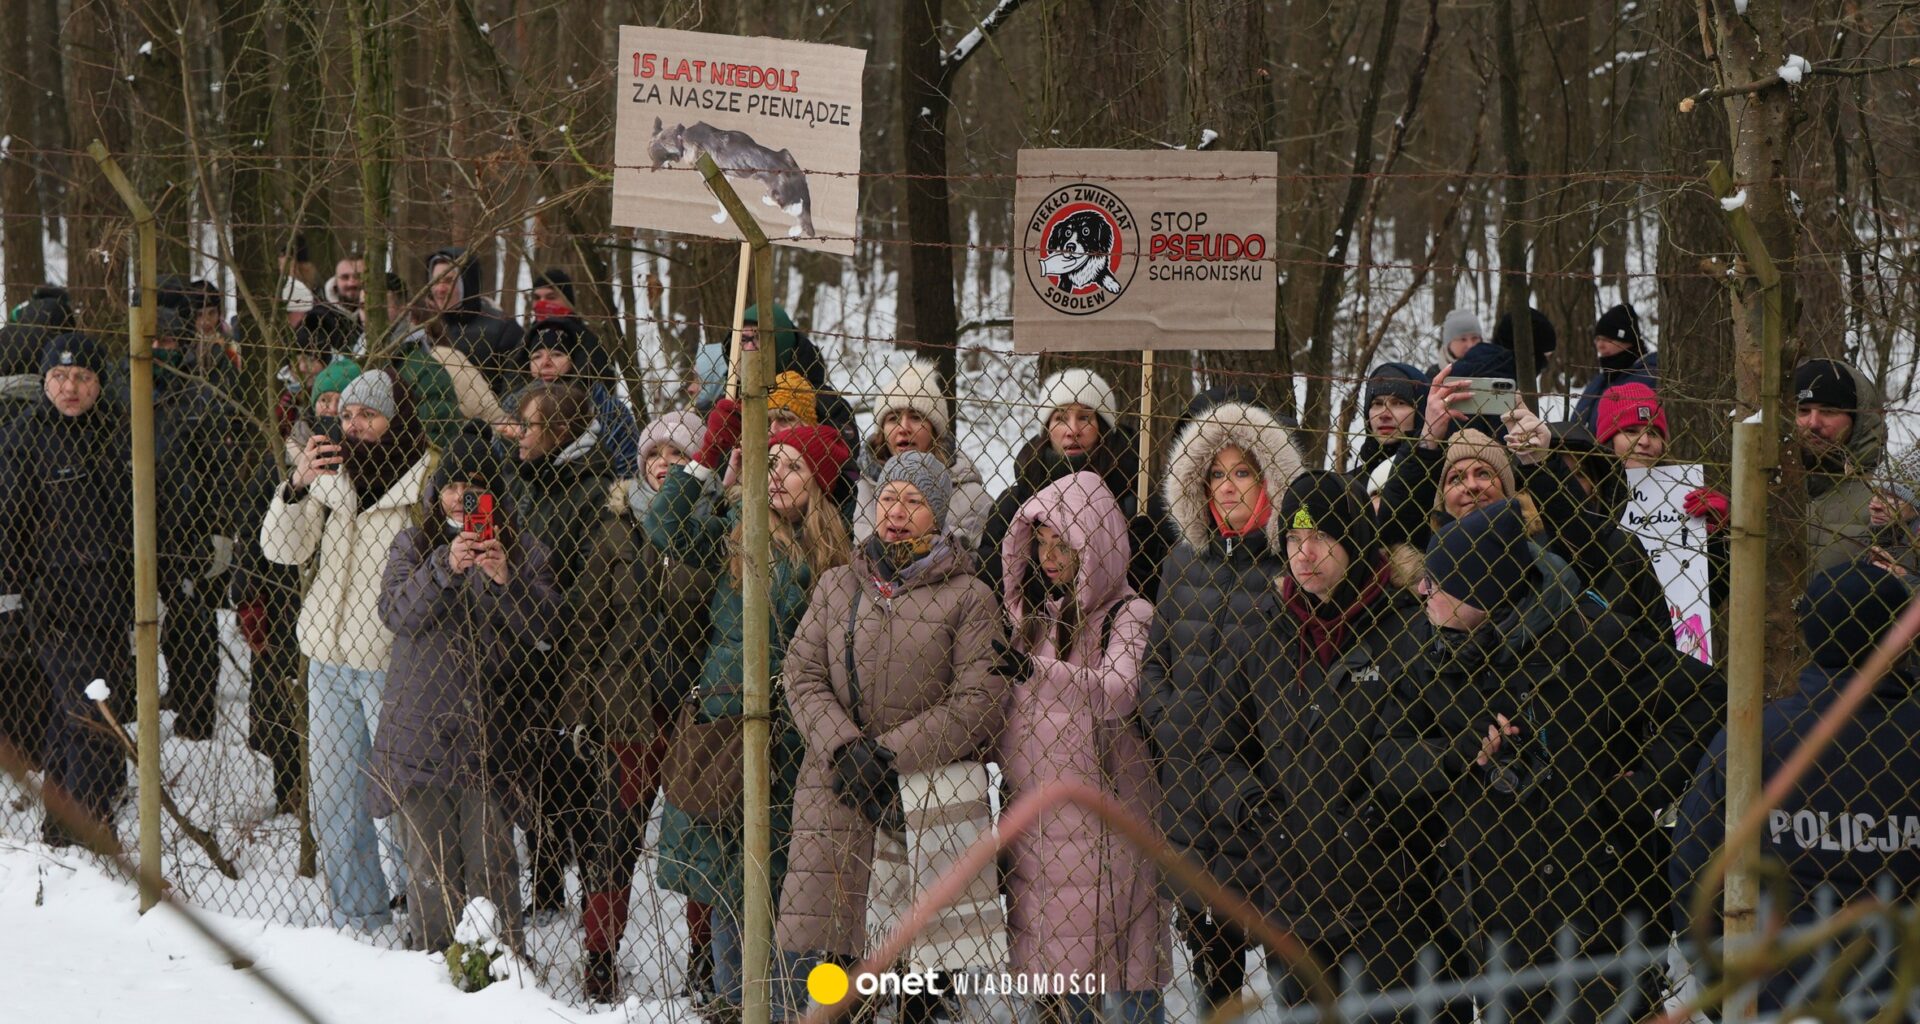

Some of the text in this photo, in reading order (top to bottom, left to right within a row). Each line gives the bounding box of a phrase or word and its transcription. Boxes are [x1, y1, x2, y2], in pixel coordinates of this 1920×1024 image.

[633, 52, 800, 93] 15 LAT NIEDOLI
[632, 82, 852, 129] ZA NASZE PIENIĄDZE
[1031, 191, 1070, 233] PIEKŁO
[1150, 211, 1208, 232] STOP
[1149, 233, 1266, 262] PSEUDO
[1148, 265, 1263, 281] SCHRONISKU
[1044, 286, 1106, 309] SOBOLEW
[1768, 808, 1920, 853] POLICJA
